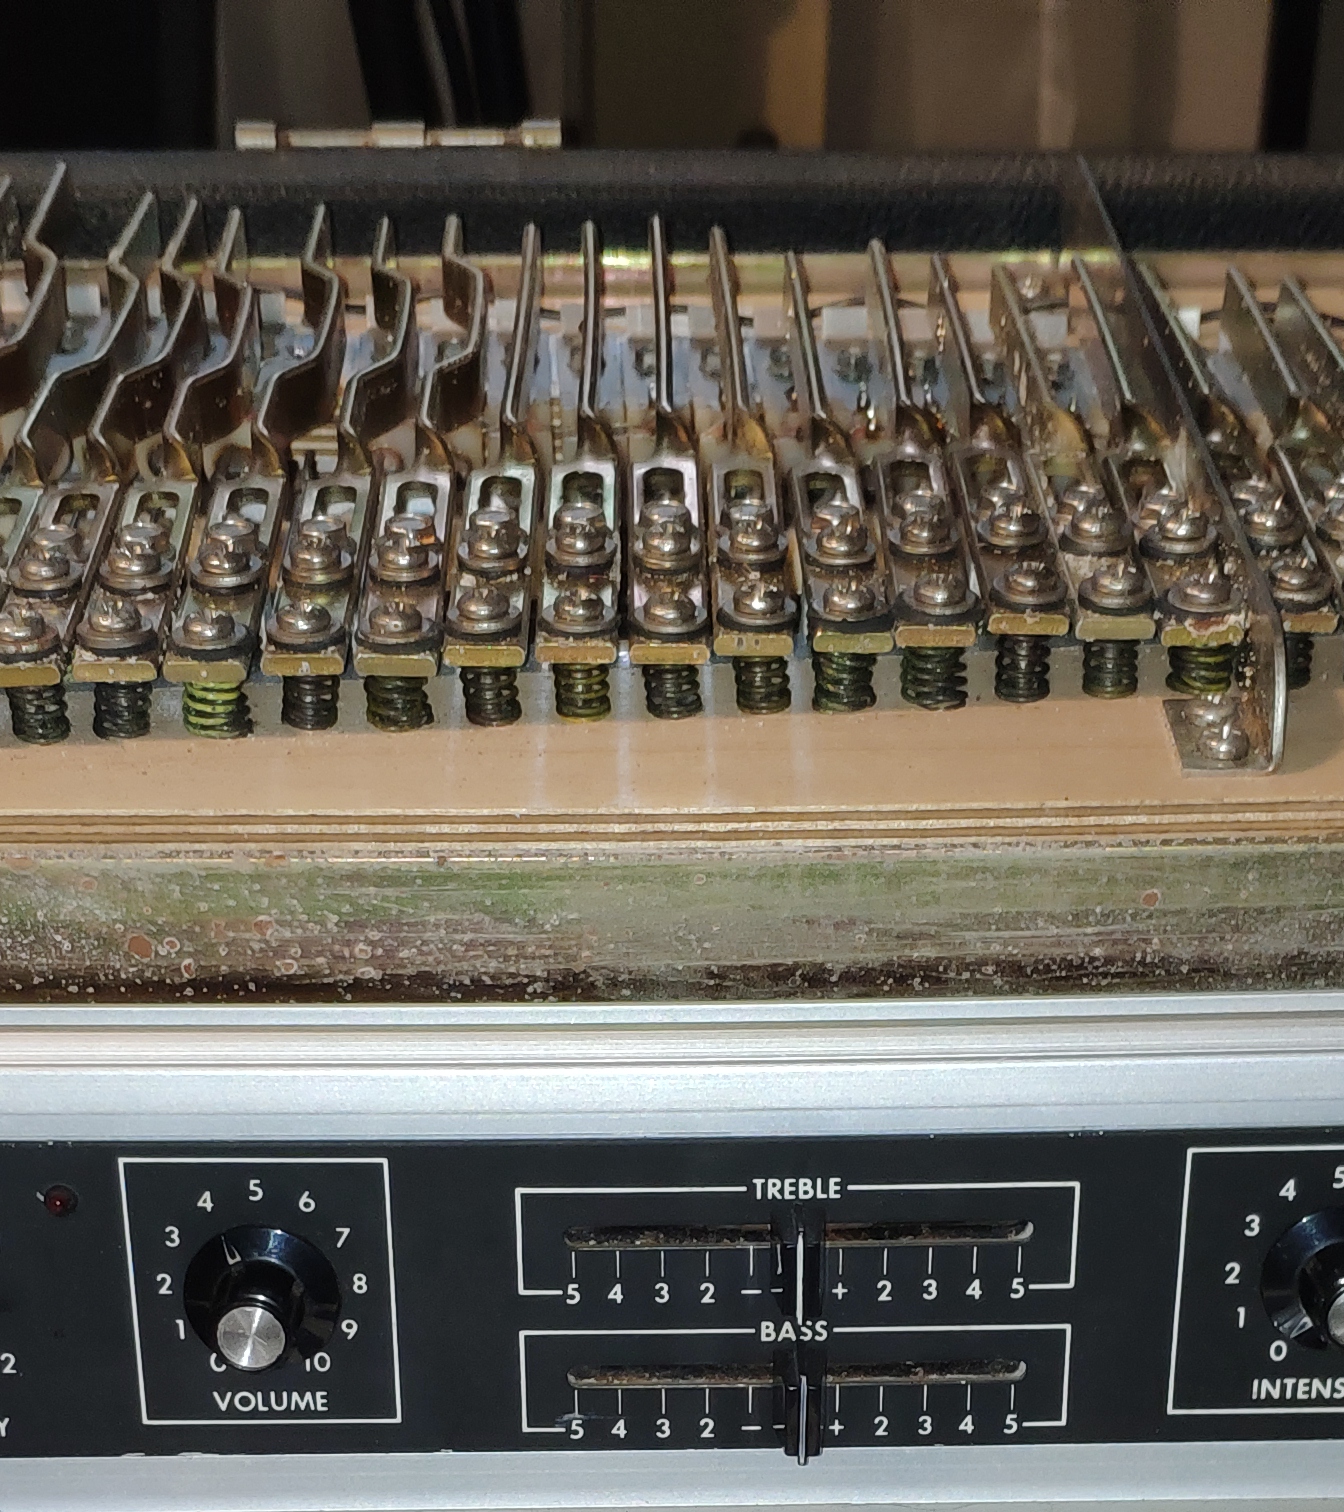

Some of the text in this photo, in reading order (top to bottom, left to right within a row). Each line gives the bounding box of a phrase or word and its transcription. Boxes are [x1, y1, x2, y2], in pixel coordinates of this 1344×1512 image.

[248, 1179, 264, 1202] 5
[751, 1177, 842, 1200] TREBLE
[1278, 1178, 1297, 1202] 4
[196, 1190, 214, 1213] 4
[298, 1190, 316, 1213] 6
[164, 1225, 181, 1248] 3
[1244, 1214, 1261, 1237] 3
[335, 1227, 351, 1249] 7
[156, 1273, 173, 1295] 2
[352, 1273, 368, 1294] 8
[1224, 1261, 1241, 1285] 2
[565, 1283, 581, 1305] 5
[607, 1283, 624, 1304] 4
[654, 1282, 670, 1304] 3
[699, 1282, 716, 1304] 2
[876, 1279, 892, 1302] 2
[922, 1278, 938, 1301] 3
[965, 1278, 983, 1300] 4
[1009, 1277, 1025, 1299] 5
[1236, 1306, 1246, 1329] 1
[175, 1318, 186, 1341] 1
[340, 1319, 359, 1341] 9
[760, 1320, 828, 1342] BASS
[1269, 1339, 1288, 1362] 0
[0, 1352, 17, 1374] 2
[212, 1390, 329, 1412] VOLUME
[569, 1419, 585, 1440] 5
[610, 1418, 628, 1439] 4
[655, 1418, 671, 1439] 3
[699, 1417, 715, 1438] 2
[873, 1415, 889, 1436] 2
[917, 1415, 933, 1435] 3
[958, 1414, 975, 1434] 4
[1003, 1413, 1018, 1435] 5
